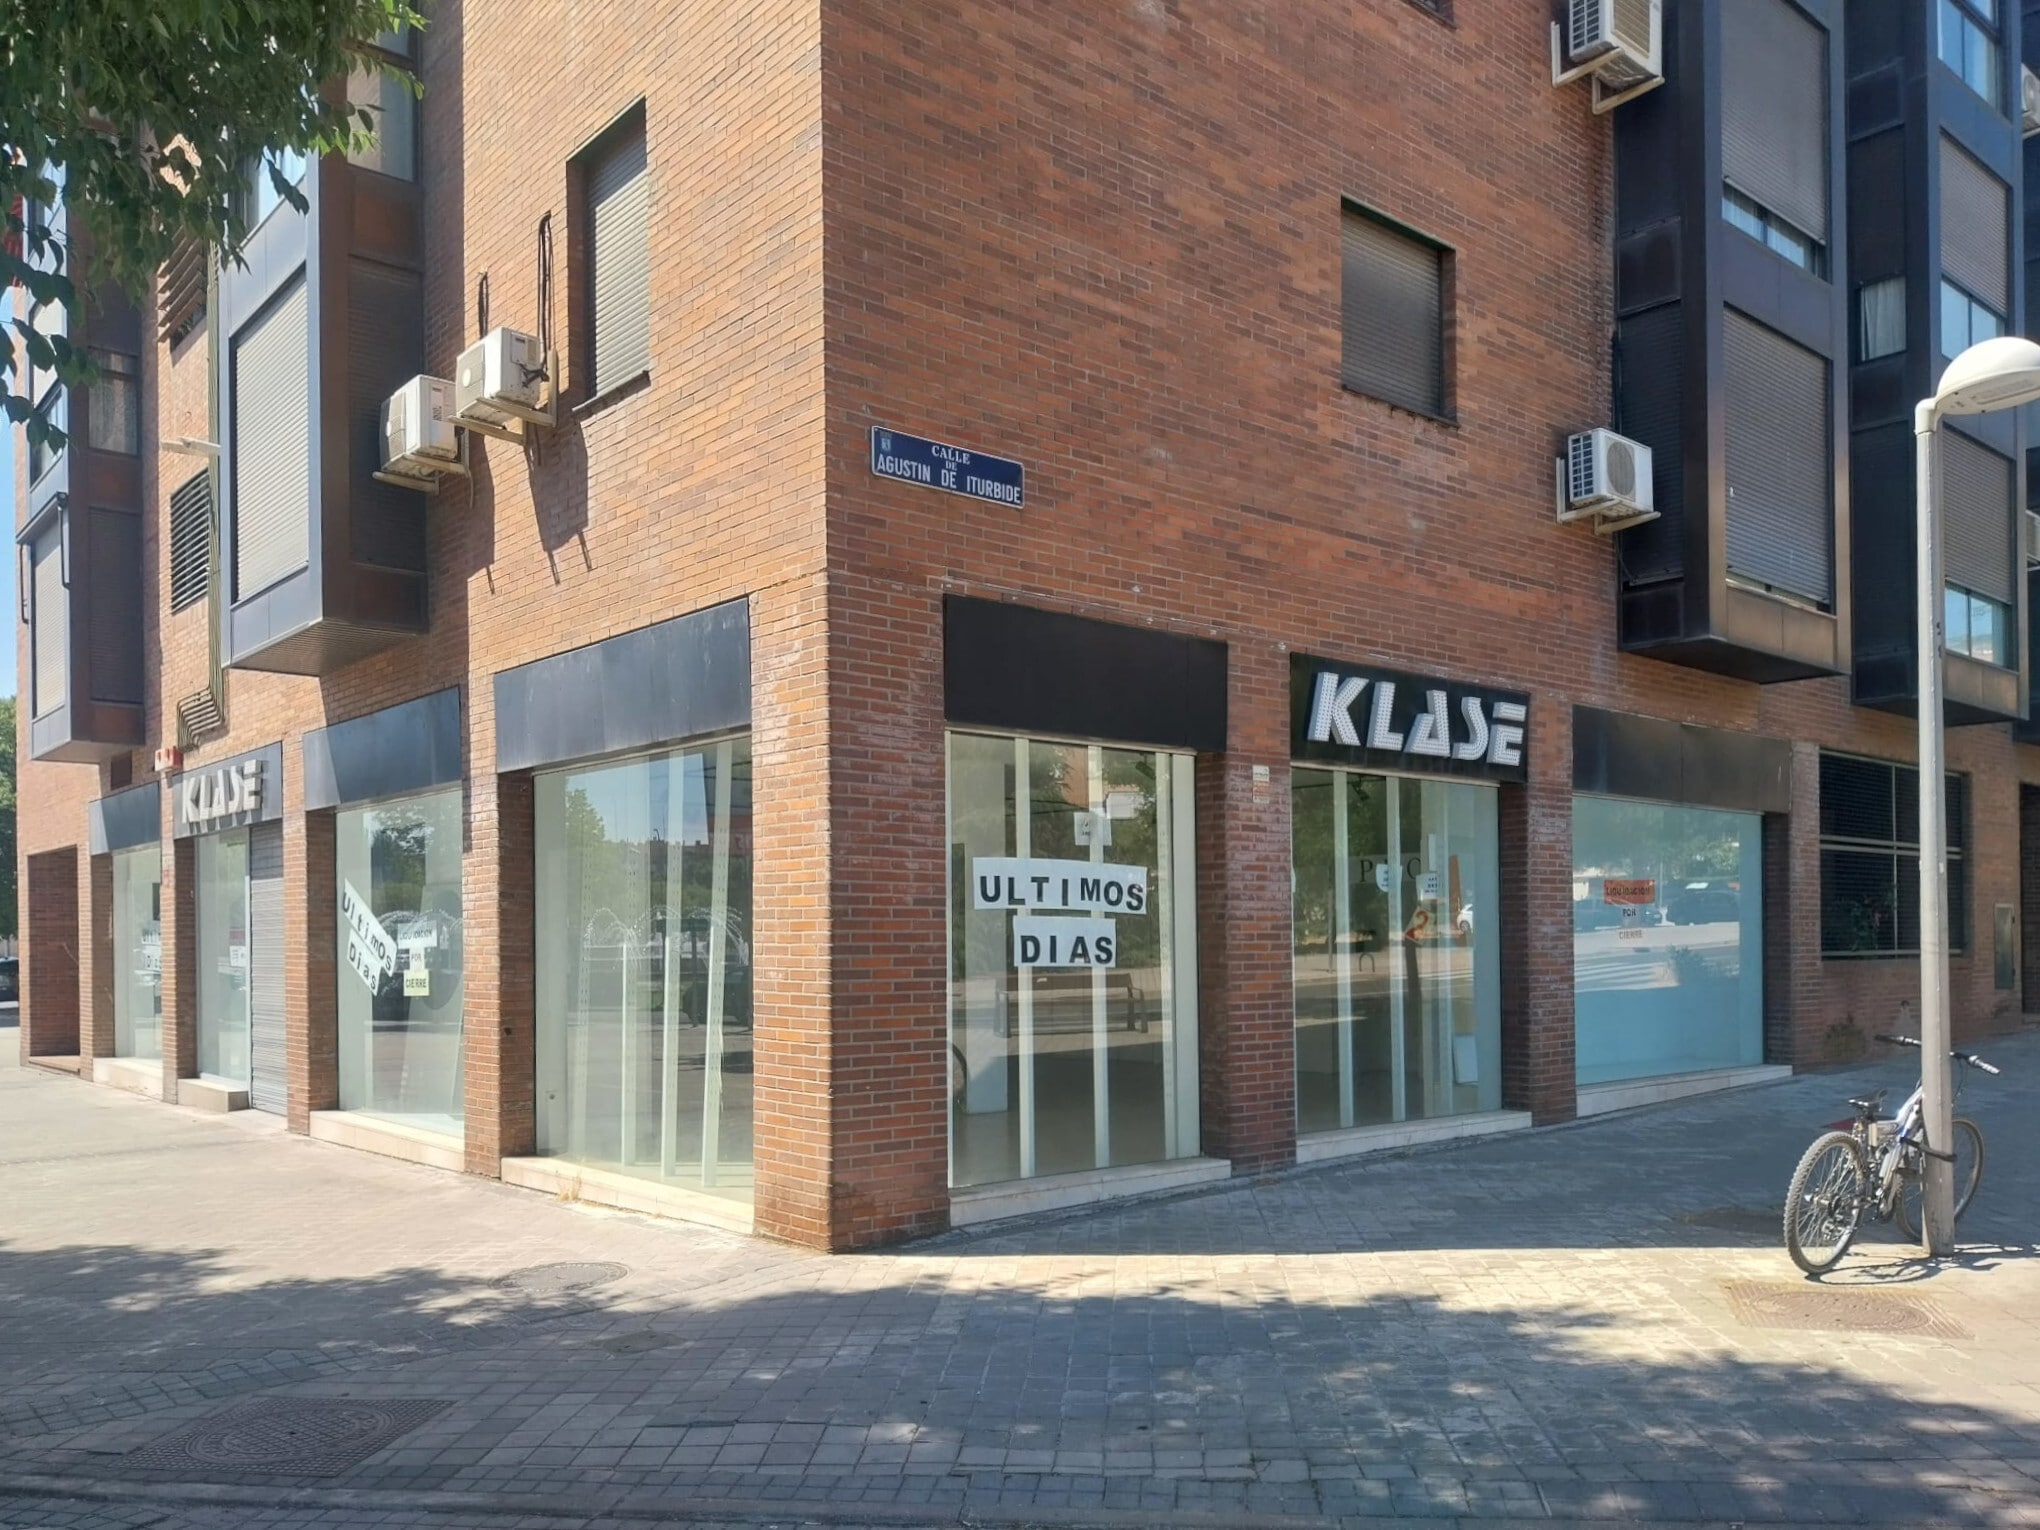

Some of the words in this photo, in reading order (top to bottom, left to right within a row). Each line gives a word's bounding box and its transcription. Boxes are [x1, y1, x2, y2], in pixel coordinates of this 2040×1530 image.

[876, 453, 931, 482] AGUSTIN
[941, 469, 957, 489] DE
[966, 475, 1021, 504] ITURBIDE
[931, 445, 970, 465] CALLE
[945, 460, 958, 471] DE
[1307, 671, 1527, 767] KLASE
[181, 759, 262, 823] KLASE
[980, 875, 1144, 912] ULTIMOS
[342, 891, 392, 971] Ultimos
[1019, 934, 1114, 964] DIAS
[349, 942, 376, 991] Dias
